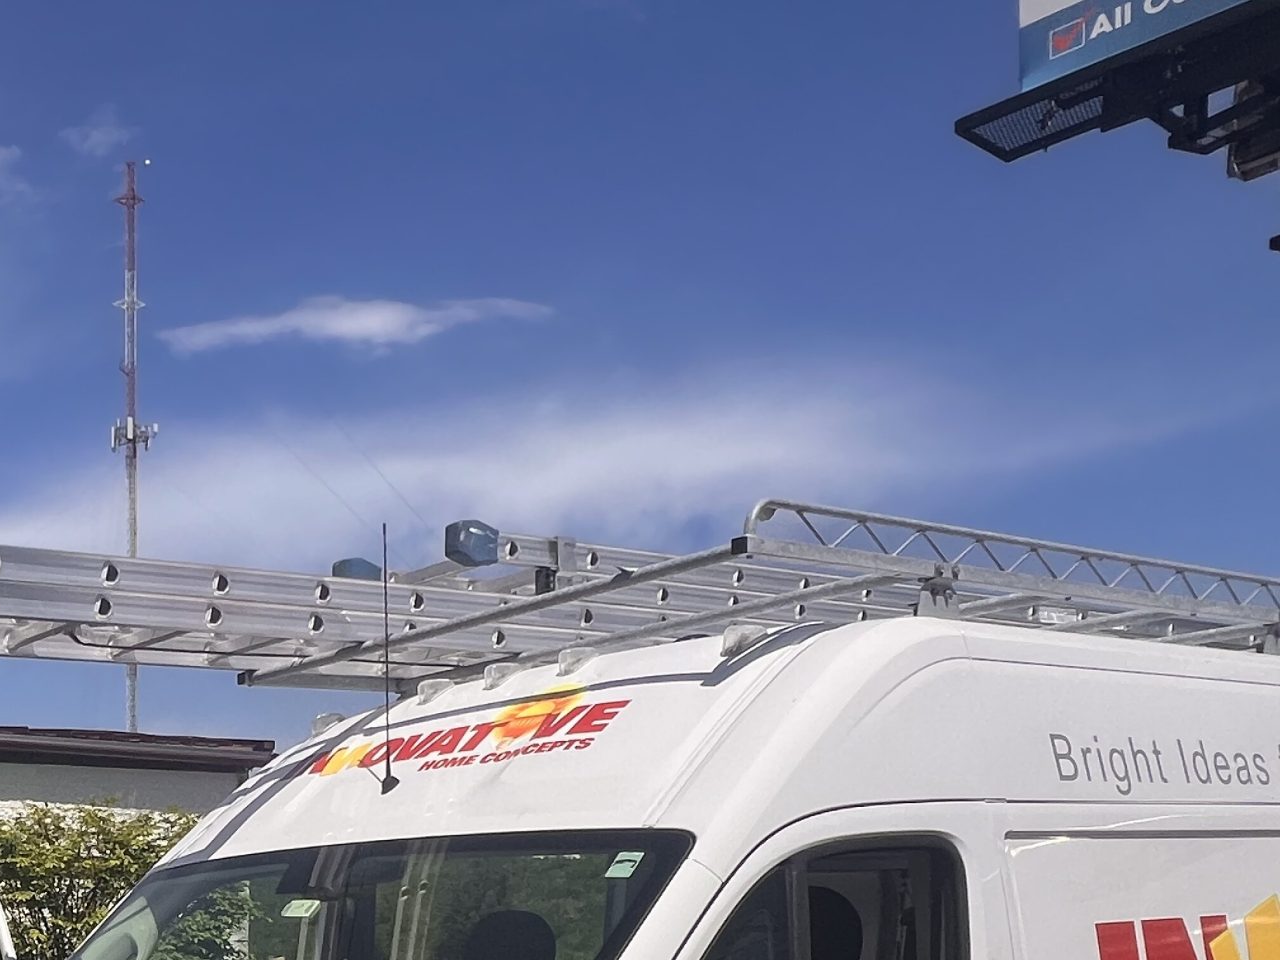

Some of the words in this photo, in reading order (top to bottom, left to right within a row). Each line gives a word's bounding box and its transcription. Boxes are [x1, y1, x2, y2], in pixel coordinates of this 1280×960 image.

[1088, 1, 1132, 40] All
[417, 755, 480, 772] HOME
[479, 738, 595, 764] CONCEPTS
[1049, 733, 1169, 796] Bright
[1176, 738, 1270, 786] Ideas
